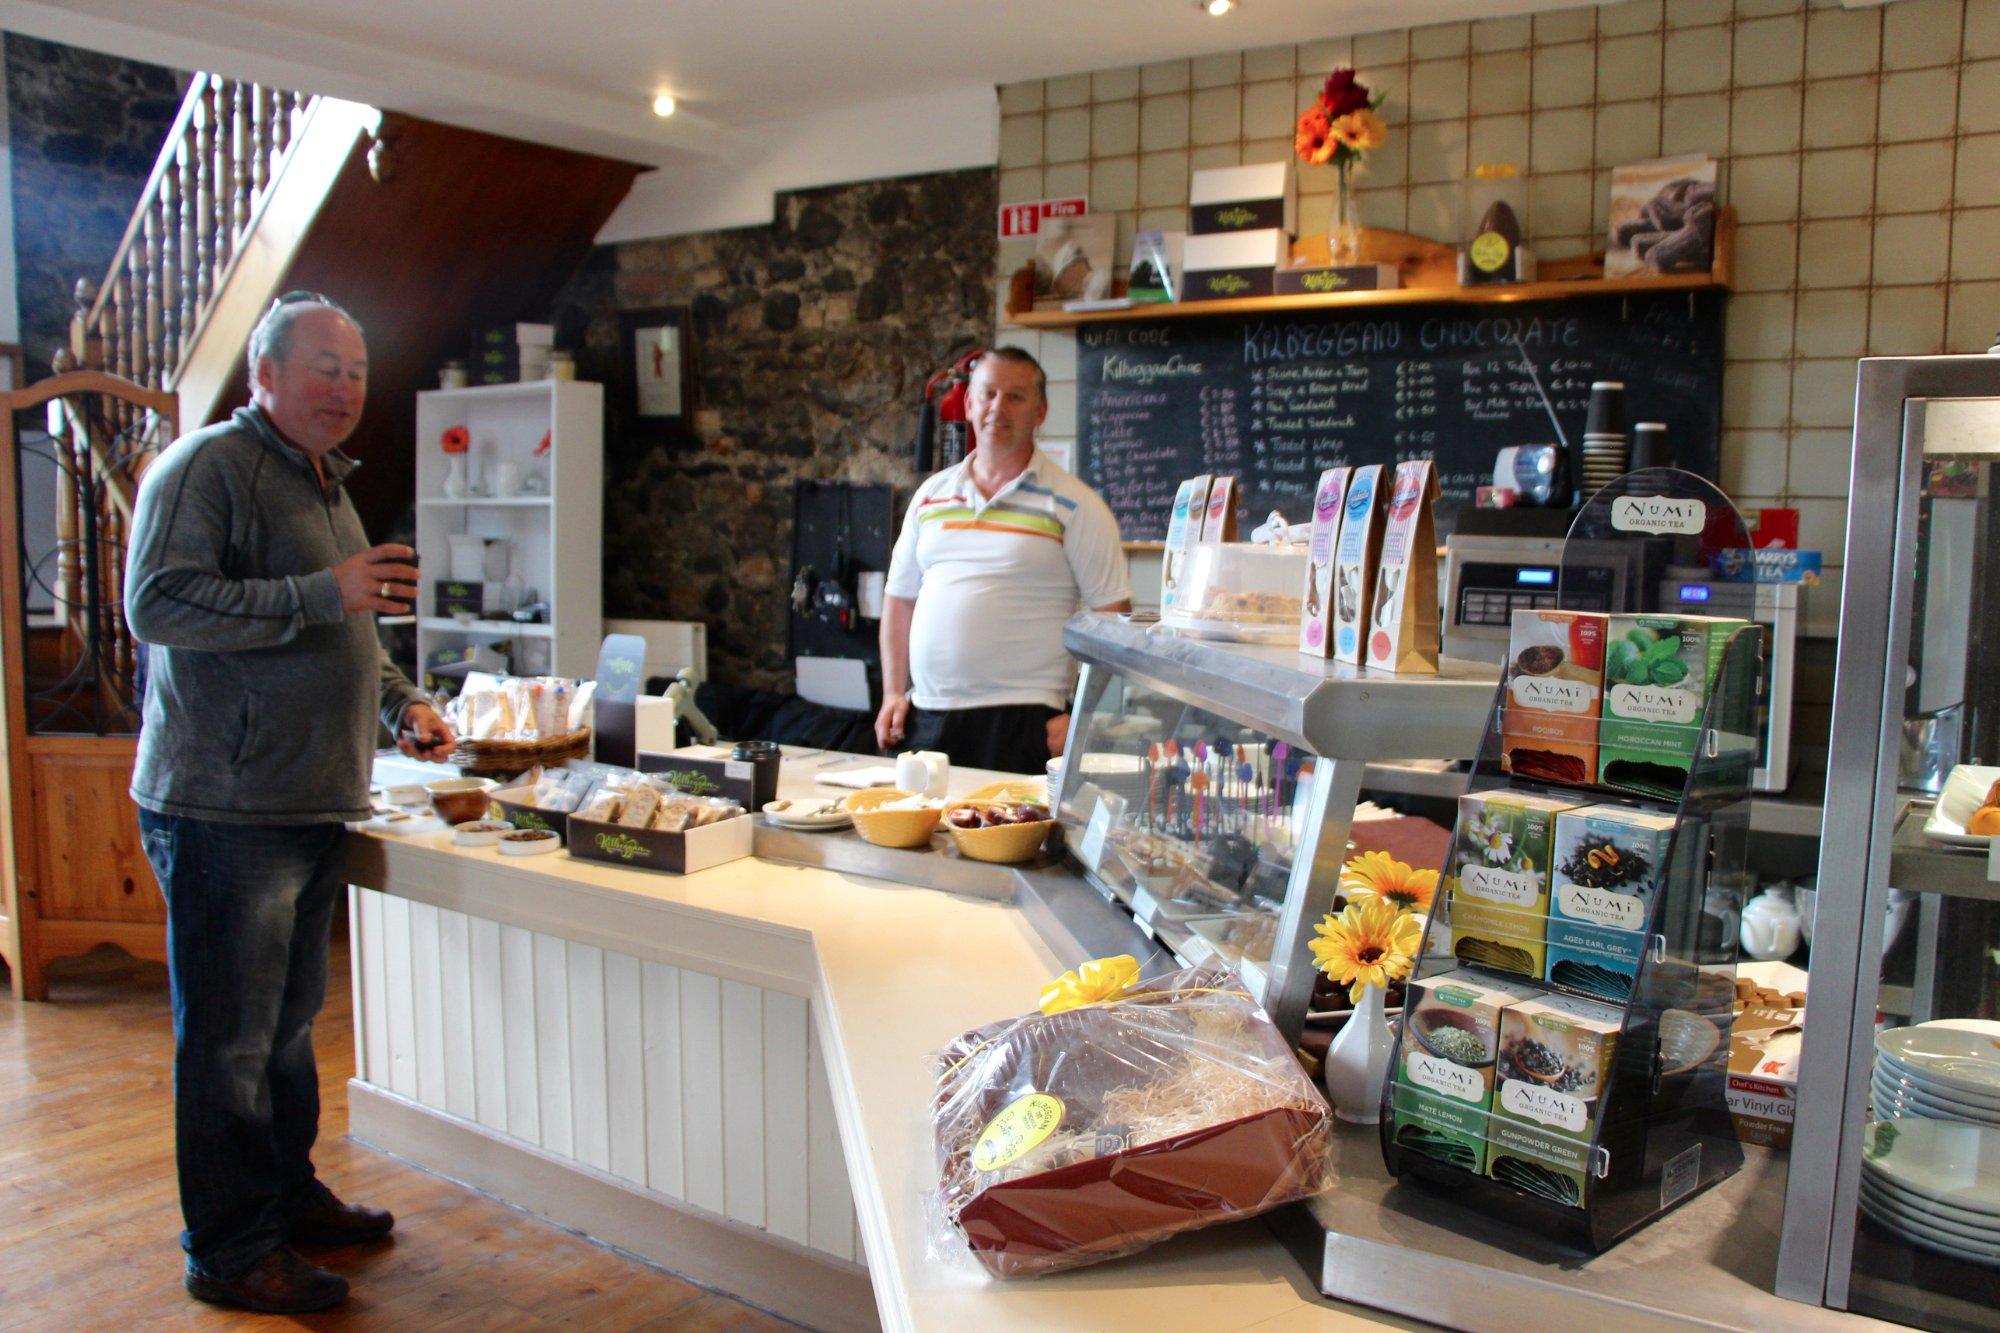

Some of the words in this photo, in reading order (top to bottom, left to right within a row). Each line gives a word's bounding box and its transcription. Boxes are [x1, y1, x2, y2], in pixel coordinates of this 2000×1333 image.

[1420, 316, 1580, 349] CHOCOLATE
[1629, 519, 1666, 527] ORGANIC
[1759, 566, 1784, 577] TEA
[1529, 695, 1558, 705] ORGANIC
[1560, 698, 1574, 706] TEA
[1627, 705, 1660, 714] ORGANIC
[1532, 725, 1564, 736] ROOIBOS
[1617, 735, 1661, 747] MOROCCAN
[1663, 740, 1683, 749] MINT
[1476, 886, 1506, 897] ORGANIC
[1576, 906, 1610, 918] ORGANIC
[1610, 913, 1625, 922] TEA
[1563, 934, 1584, 945] AGED
[1585, 939, 1605, 950] EARL
[1422, 1075, 1452, 1089] ORGANIC
[1452, 1083, 1467, 1093] TEA
[1731, 1080, 1753, 1089] Chef's
[1754, 1083, 1780, 1094] Kitchen
[1519, 1103, 1552, 1118] ORGANIC
[1553, 1112, 1568, 1122] TEA
[1742, 1097, 1774, 1114] Vinyl
[1777, 1104, 1796, 1117] Glo
[1739, 1118, 1767, 1132] Powder
[1768, 1123, 1786, 1134] Free
[1501, 1129, 1551, 1151] GUNPOWDER
[1551, 1145, 1578, 1160] GREEN
